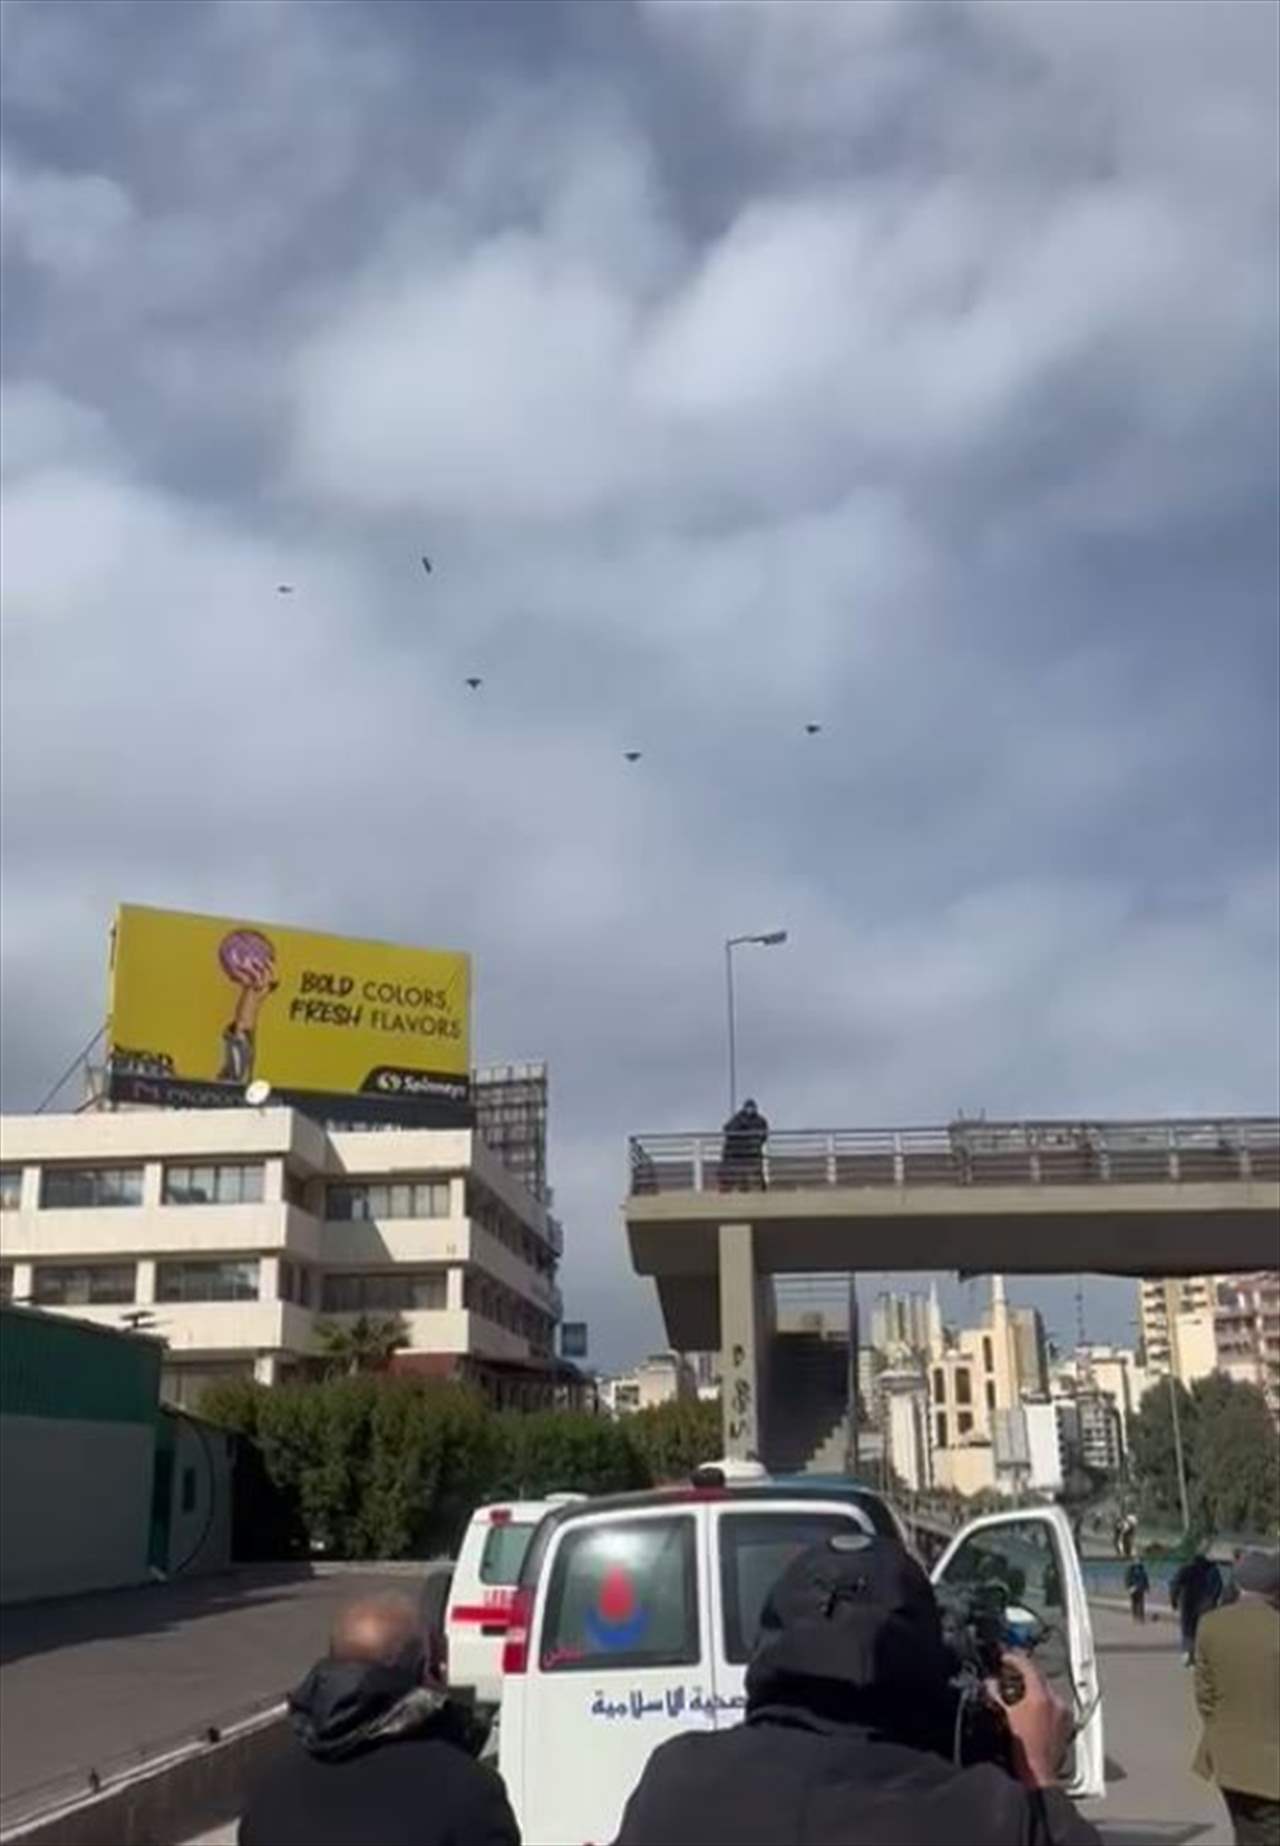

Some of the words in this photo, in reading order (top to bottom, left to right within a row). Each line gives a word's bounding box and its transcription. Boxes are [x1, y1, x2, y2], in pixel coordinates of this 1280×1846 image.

[300, 970, 354, 997] BOLD
[289, 996, 363, 1027] FRESH
[371, 1009, 462, 1039] FLAVORS
